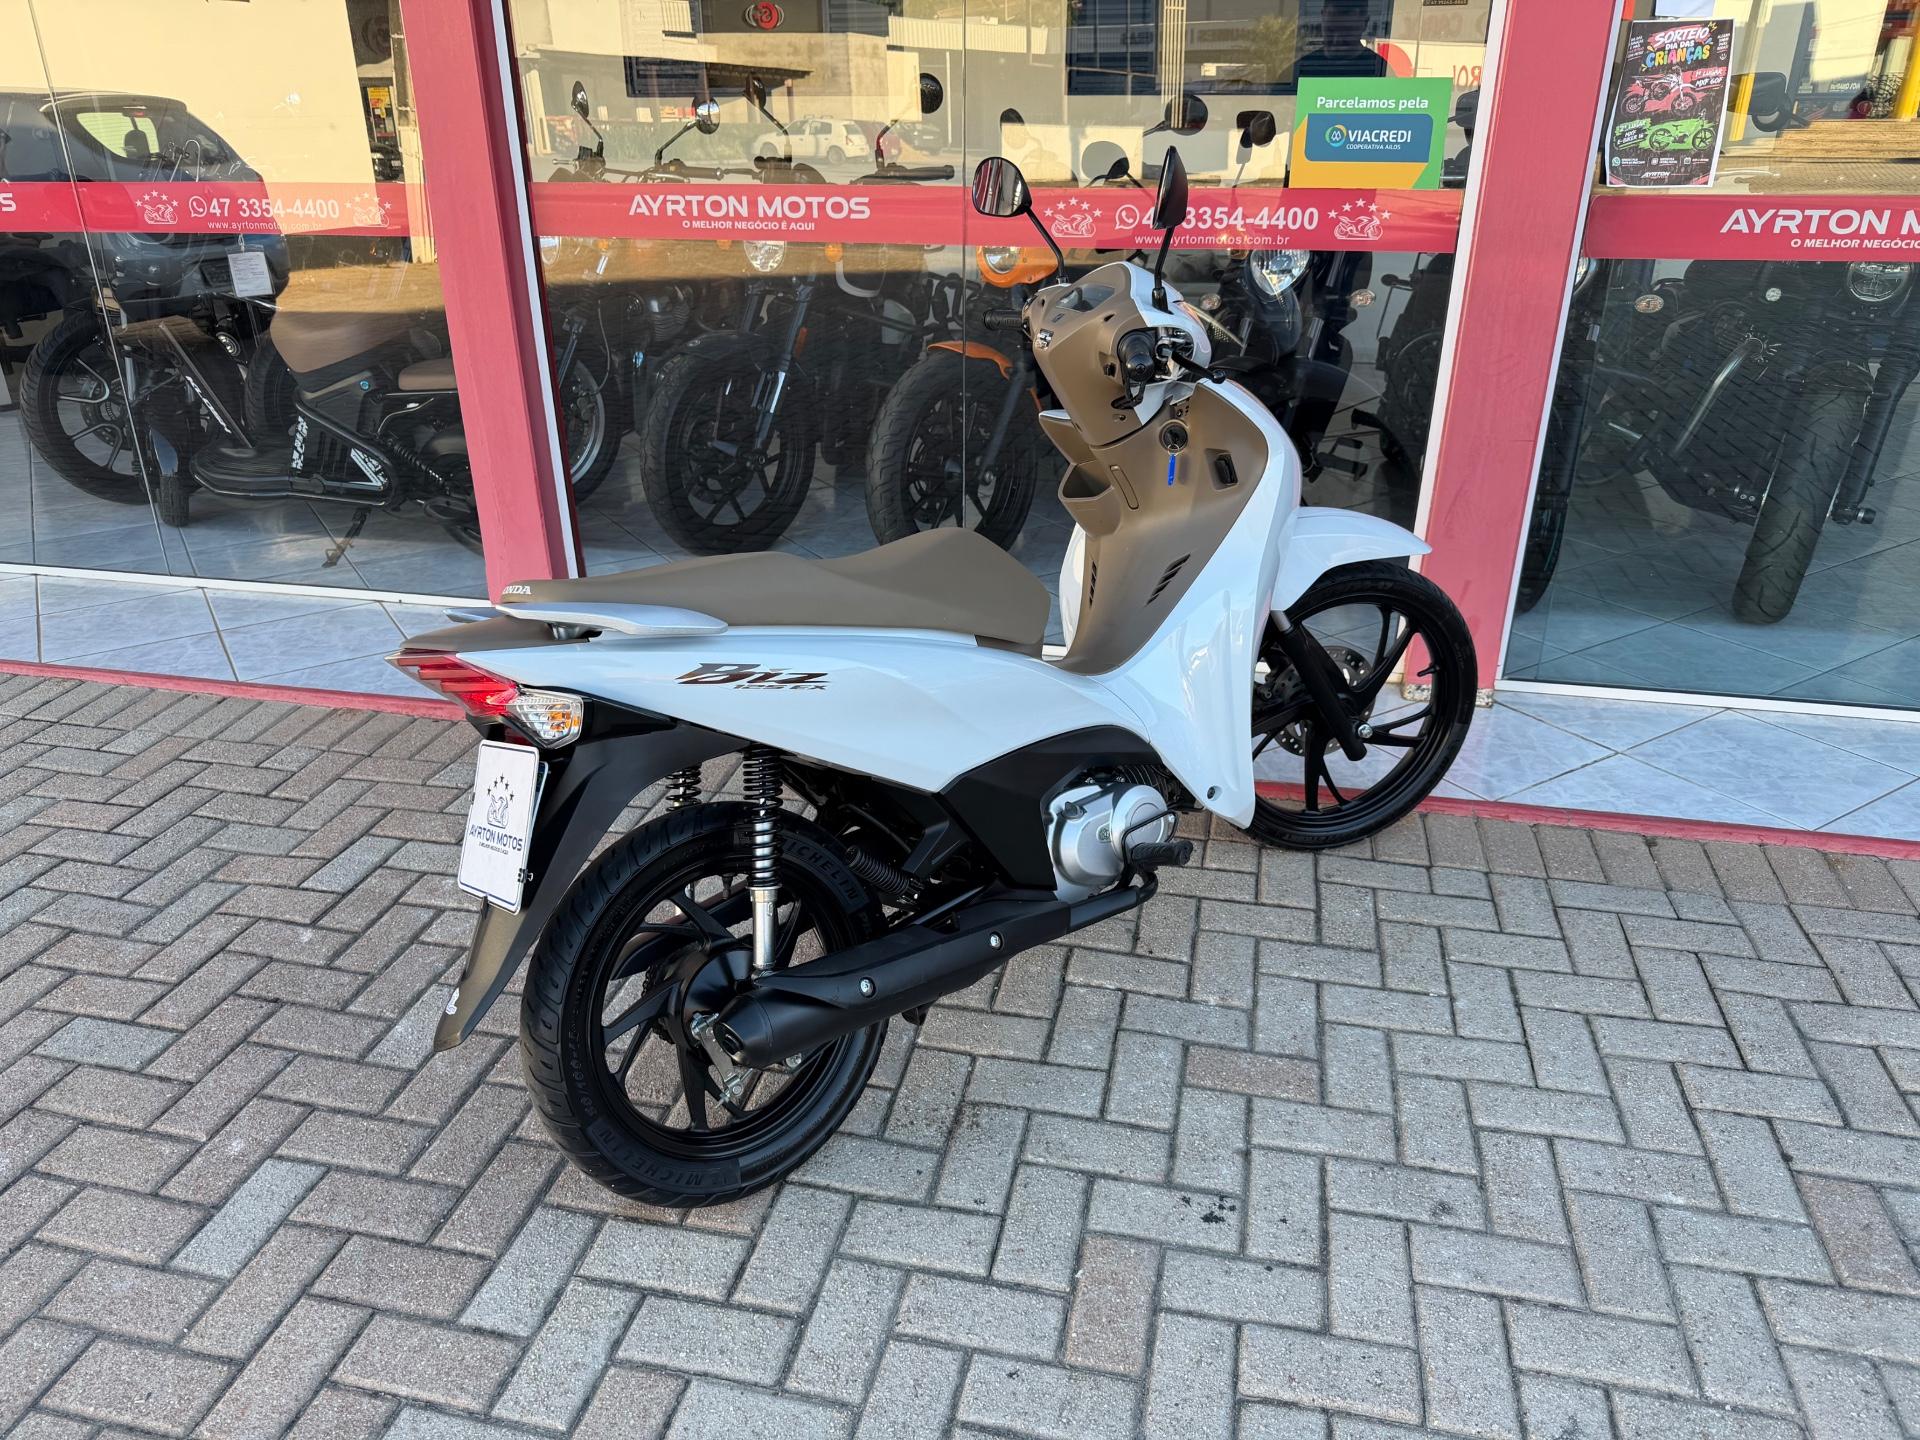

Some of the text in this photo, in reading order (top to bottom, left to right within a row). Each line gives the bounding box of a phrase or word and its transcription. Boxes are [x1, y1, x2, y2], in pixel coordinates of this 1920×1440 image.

[1654, 27, 1710, 48] SORTEIO
[1665, 39, 1695, 50] DIA DAS
[1316, 96, 1429, 111] Parcelamos pela
[1348, 130, 1411, 143] VIACREDI
[209, 198, 339, 219] 47 3354-4400
[628, 194, 871, 220] AYRTON MOTOS
[1182, 206, 1320, 230] 3354-4400
[682, 219, 815, 231] O MELHOR NEGÓCIO É AQUI
[1720, 208, 1891, 235] AYRTON
[1790, 238, 1801, 248] O
[1803, 238, 1860, 249] MELHOR
[675, 662, 832, 685] Biz
[469, 824, 496, 844] AYRTON
[496, 831, 523, 852] MOTOS
[786, 840, 859, 901] ICHELIN
[598, 1129, 706, 1187] MICHELIN
